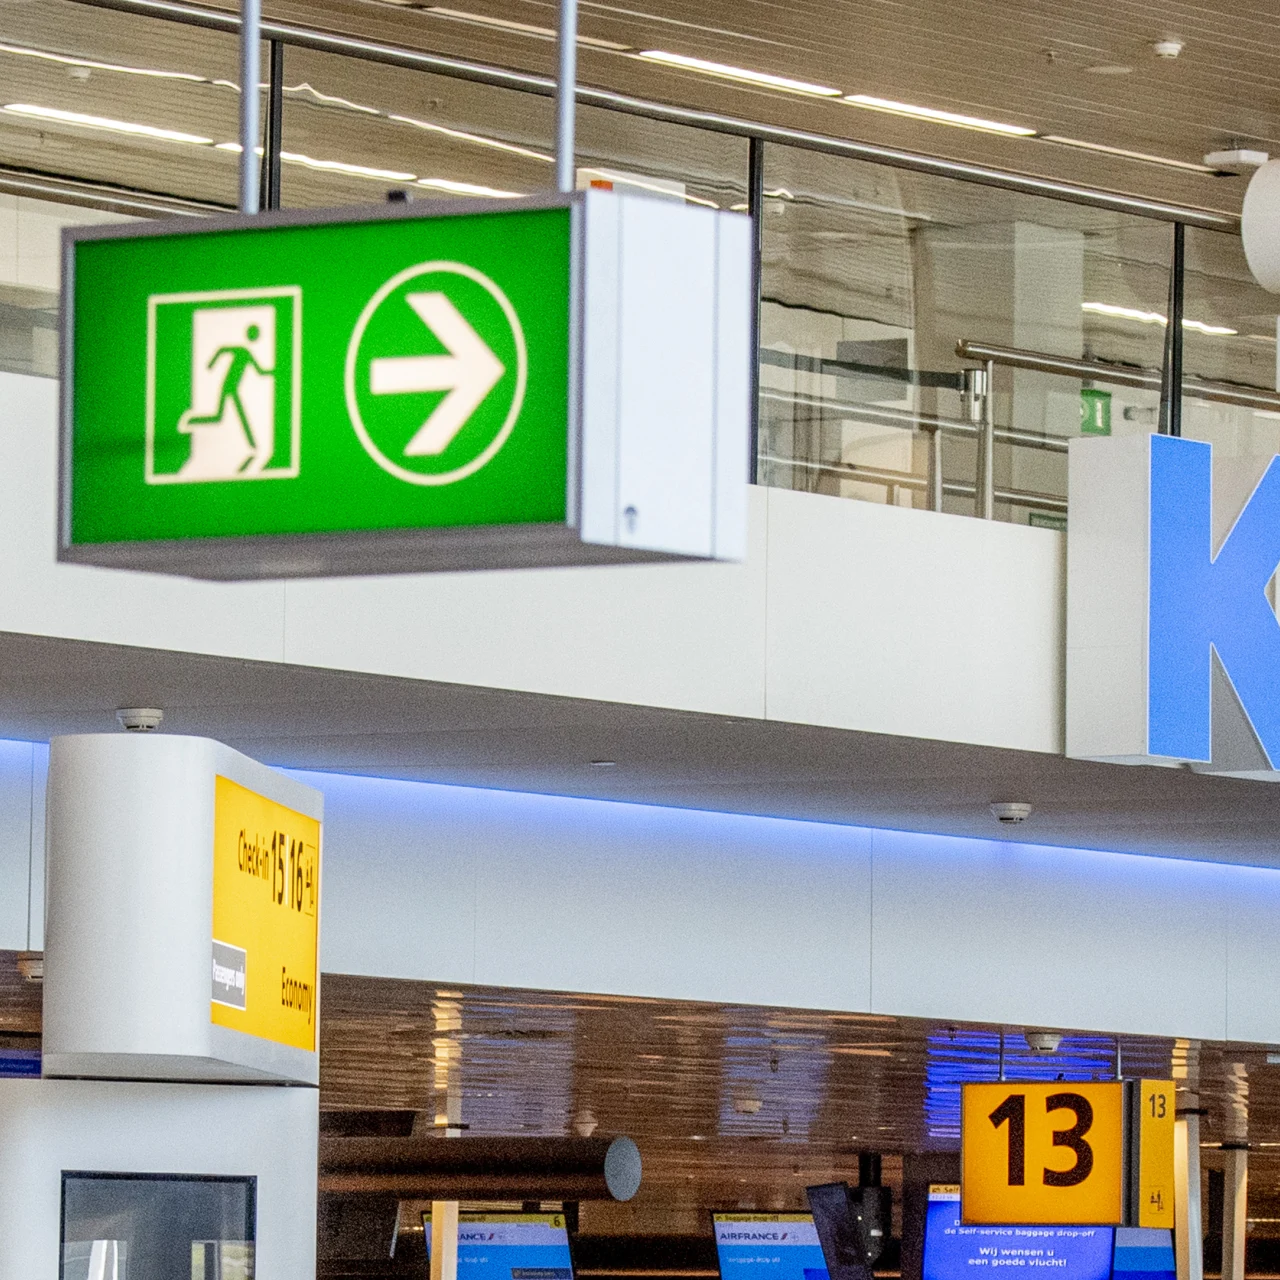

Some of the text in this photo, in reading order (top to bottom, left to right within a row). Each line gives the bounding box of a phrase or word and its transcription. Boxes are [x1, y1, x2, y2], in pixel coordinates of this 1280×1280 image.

[237, 828, 303, 913] Check-in 15 16
[281, 966, 313, 1025] Economy
[1148, 1094, 1166, 1118] 13
[988, 1092, 1094, 1187] 13
[553, 1216, 561, 1227] 6
[720, 1232, 779, 1240] AIRFRANCE
[1015, 1229, 1055, 1237] baggage
[1057, 1229, 1095, 1237] drop-off
[979, 1248, 998, 1257] Wij
[992, 1259, 1025, 1267] goede
[1029, 1259, 1067, 1267] vlucht!
